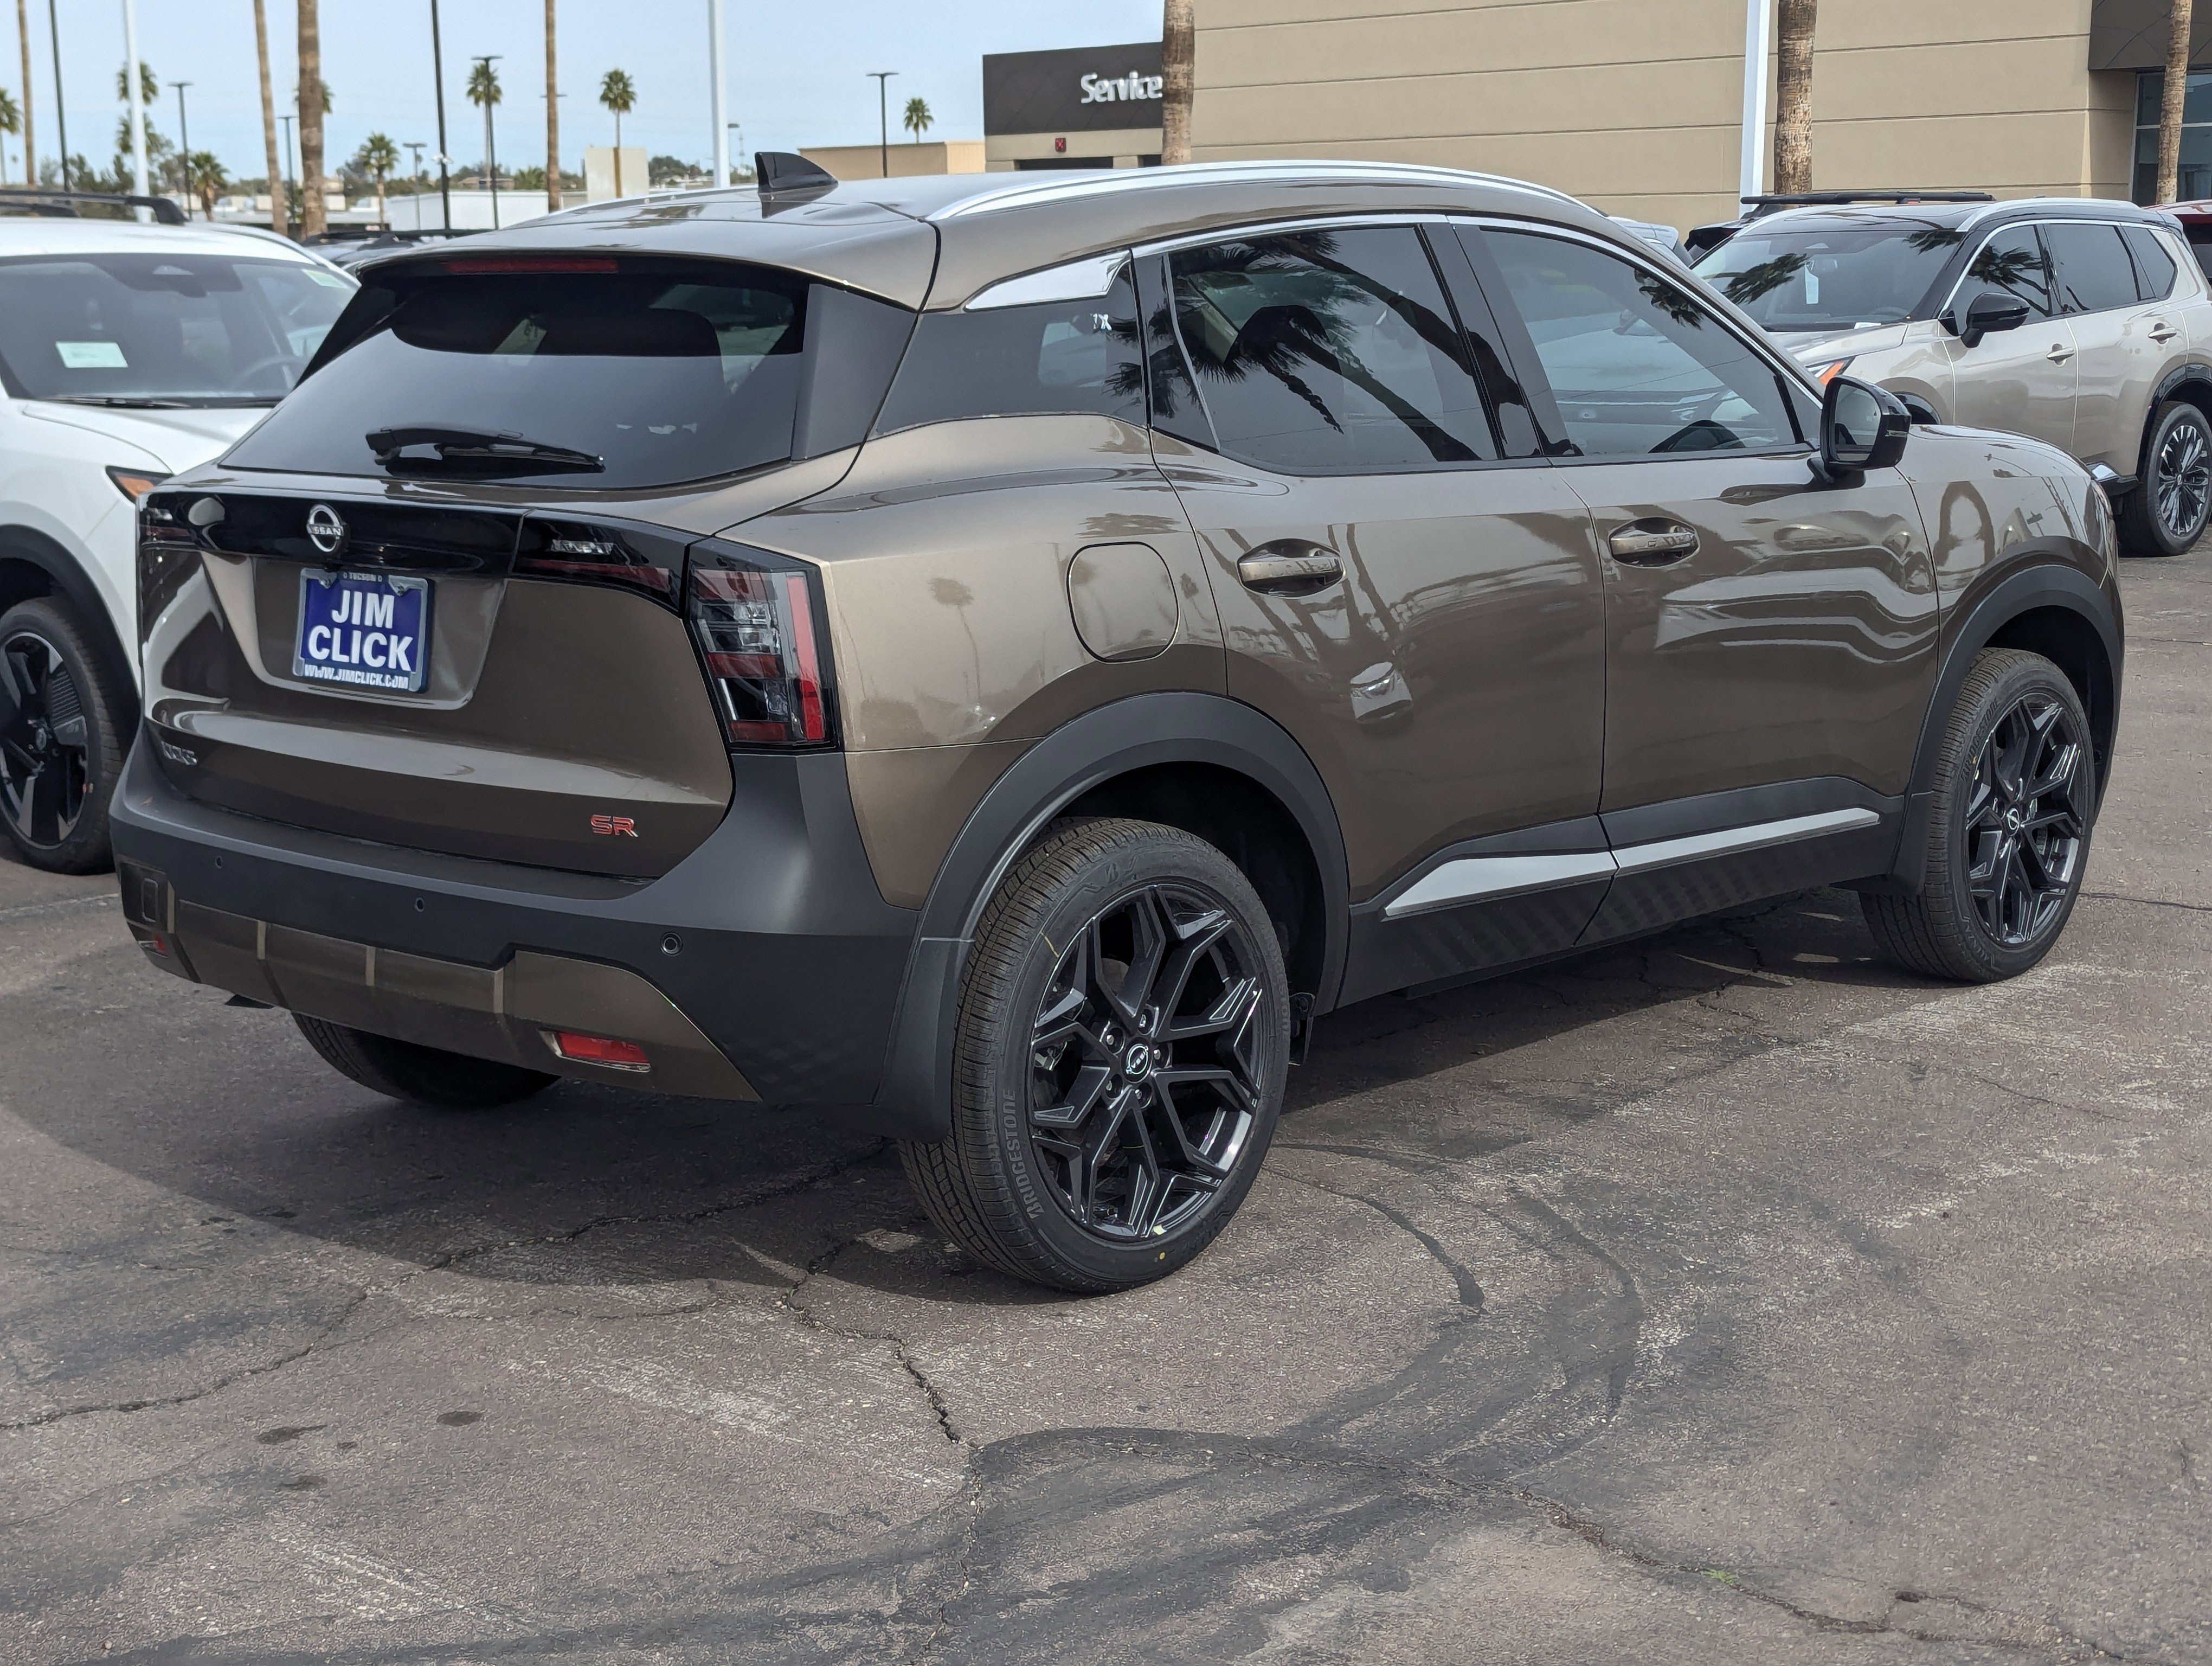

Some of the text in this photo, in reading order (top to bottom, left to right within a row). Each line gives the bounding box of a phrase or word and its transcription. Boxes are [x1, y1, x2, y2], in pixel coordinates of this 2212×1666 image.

[1081, 71, 1163, 103] Service
[331, 589, 395, 629] JIM
[308, 625, 414, 671] CLICK
[304, 664, 409, 689] WWW.JIMCLICK.COM
[590, 814, 639, 837] SR
[1003, 1089, 1045, 1219] BRIDGESTONE
